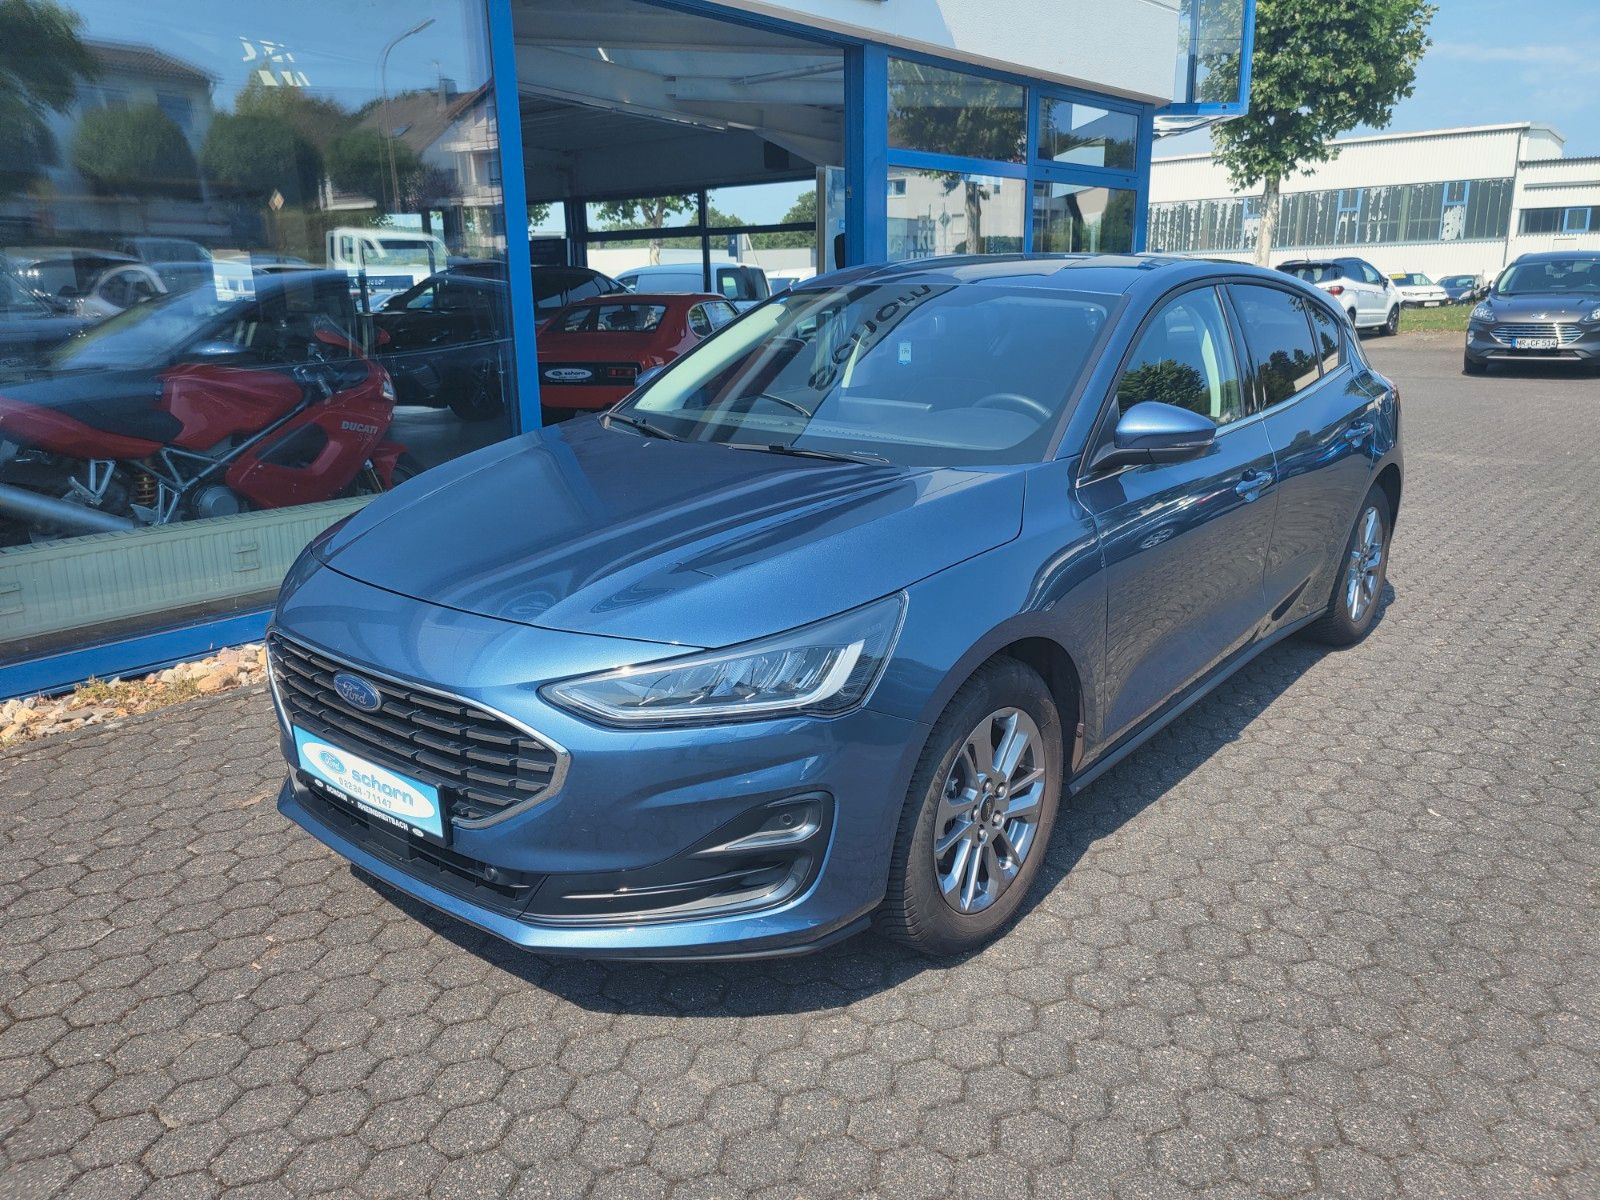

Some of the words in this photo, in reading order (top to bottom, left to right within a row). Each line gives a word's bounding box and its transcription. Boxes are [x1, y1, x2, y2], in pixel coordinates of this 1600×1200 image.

[1541, 339, 1556, 347] 514
[341, 420, 378, 434] DUCATI
[351, 767, 414, 807] schorn
